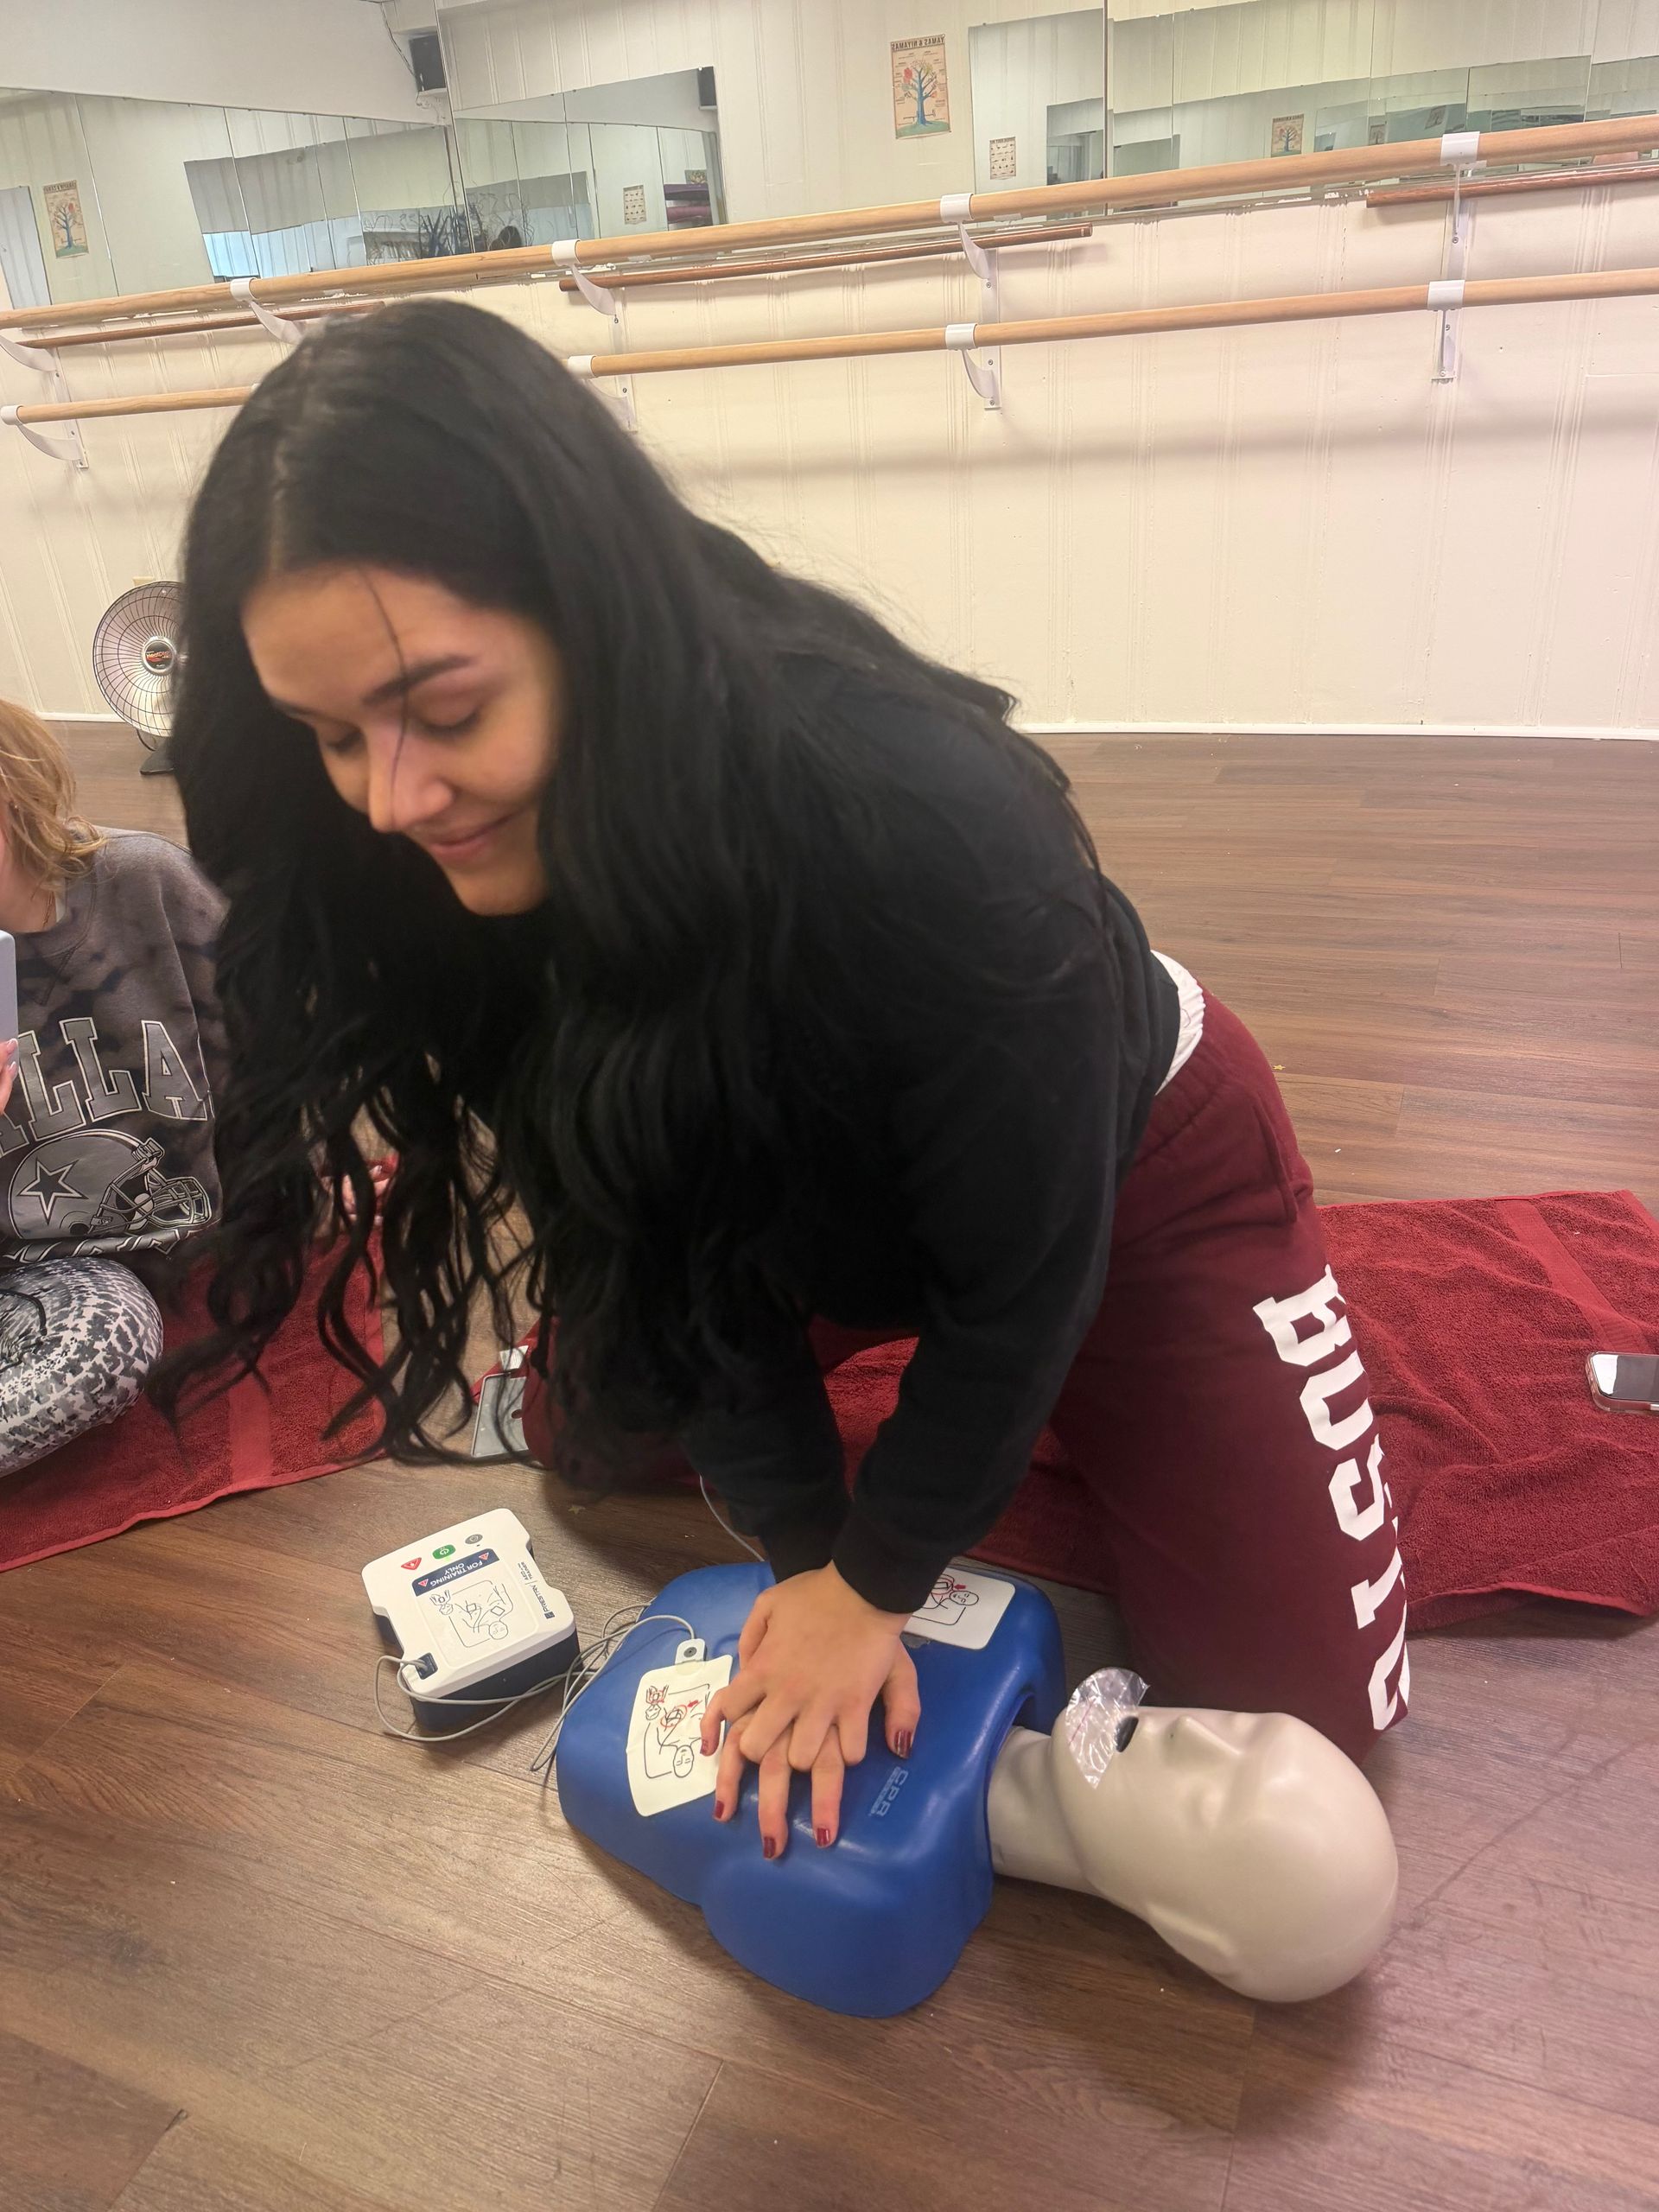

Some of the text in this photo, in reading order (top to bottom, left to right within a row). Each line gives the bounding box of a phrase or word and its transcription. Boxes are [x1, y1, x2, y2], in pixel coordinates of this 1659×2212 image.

[0, 1016, 208, 1158] LLA
[429, 1560, 483, 1586] FOR TRAINING
[444, 1562, 464, 1575] ONLY
[876, 1770, 908, 1816] CPR
